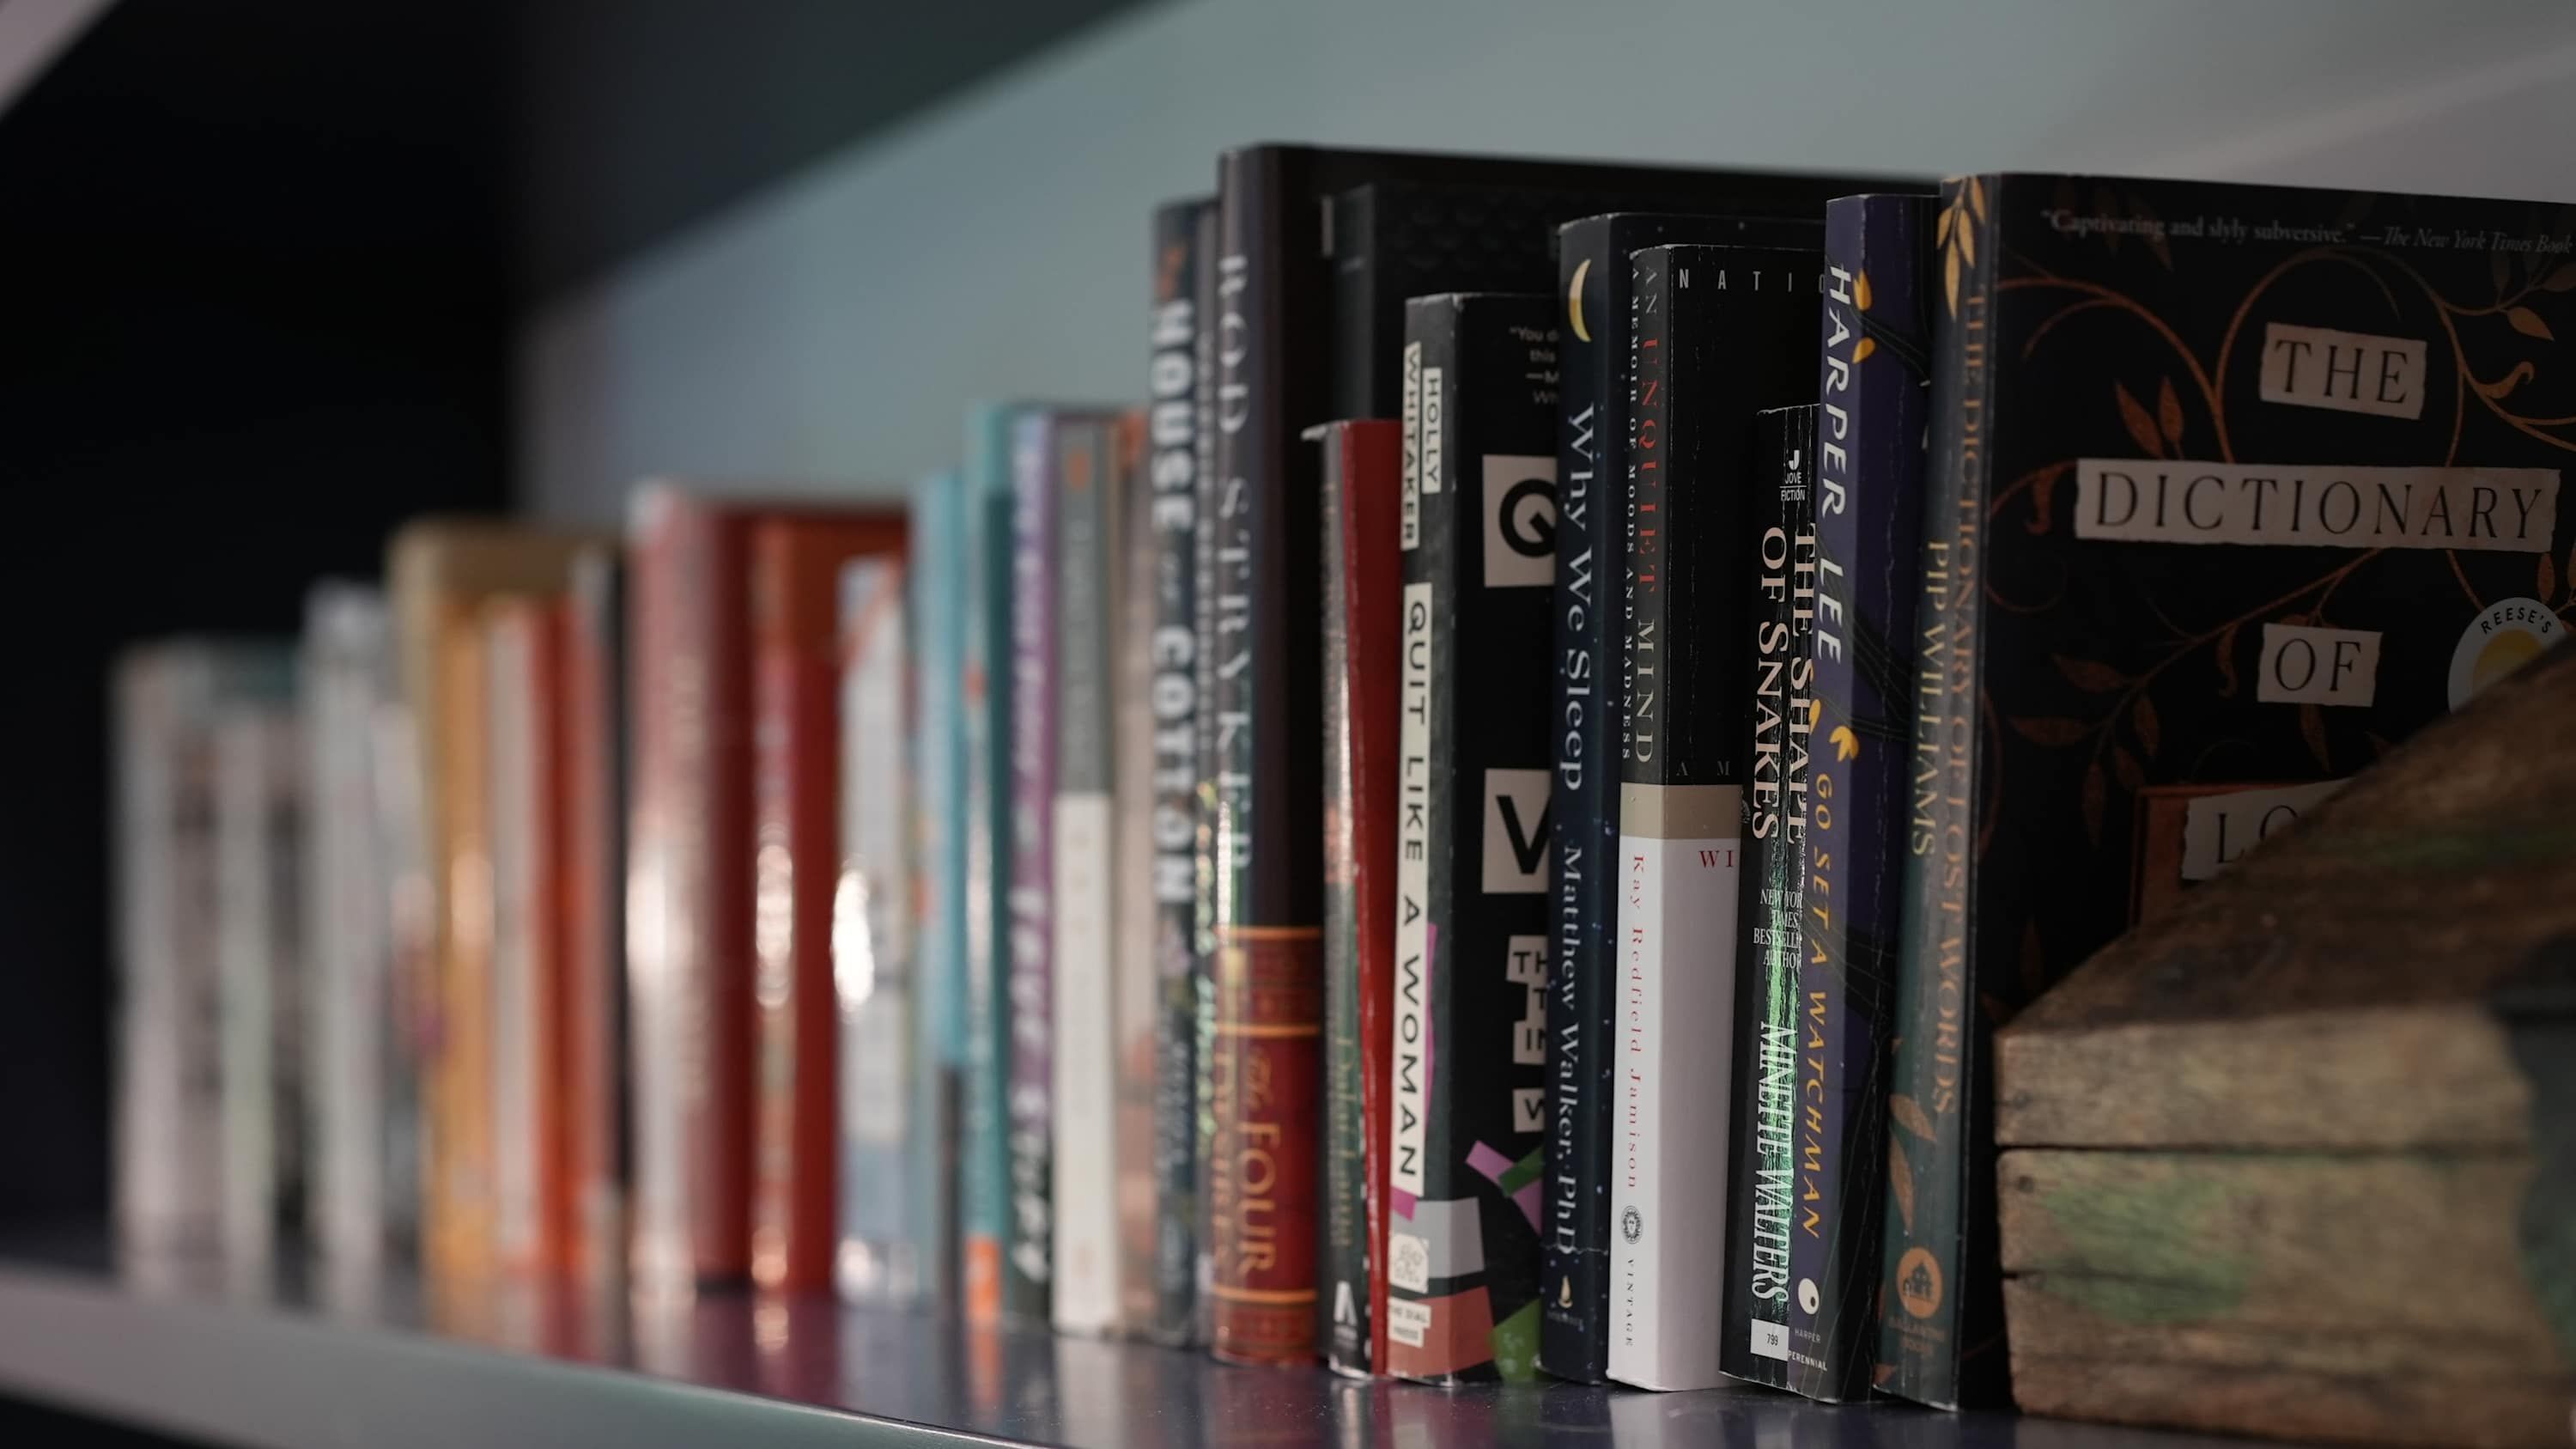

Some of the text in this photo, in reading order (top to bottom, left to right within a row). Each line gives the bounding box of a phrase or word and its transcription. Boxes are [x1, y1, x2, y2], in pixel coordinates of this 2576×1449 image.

[2169, 216, 2204, 237] and
[2208, 216, 2248, 244] slyly
[2415, 228, 2450, 248] New
[2452, 228, 2488, 250] York
[2490, 231, 2532, 253] Times
[2535, 233, 2573, 254] Book
[1629, 295, 1639, 402] MEMOIR
[1965, 284, 1986, 385] THE
[2274, 338, 2410, 405] THE
[1403, 347, 1419, 540] WHITAKER
[1425, 376, 1440, 485] HOLLY
[1627, 417, 1637, 449] OF
[1785, 472, 1801, 484] JOVE
[1817, 261, 1852, 665] HARPER LEE
[1626, 464, 1637, 553] MOODS
[1780, 489, 1805, 502] FICTION
[1951, 399, 1981, 701] DICTIONARY
[2095, 470, 2543, 539] DICTIONARY
[1558, 400, 1595, 791] Why We Sleep
[1625, 567, 1635, 620] AND
[2481, 606, 2552, 634] REESE'S
[1621, 635, 1633, 760] MADNESS
[1635, 618, 1656, 763] MIND
[1753, 526, 1789, 839] OF SNAKES
[1787, 521, 1816, 844] THE SHAPE
[1911, 540, 1950, 856] PIP WILLIAMS
[2274, 637, 2362, 693] OF
[1400, 601, 1426, 1175] QUIT LIKE A WOMAN
[1561, 844, 1583, 1011] Matthew
[1759, 888, 1803, 909] NEW YOR
[1627, 855, 1644, 1187] Kay Redfield Jamison
[1802, 773, 1833, 1239] GO SET A WATCHMAN
[1934, 936, 1963, 1114] WORDS
[1237, 1120, 1281, 1275] FOUR
[1556, 1173, 1577, 1255] PhD
[1752, 1020, 1798, 1303] MINETTE WALTERS
[1788, 1349, 1828, 1372] PERENNIAL
[1794, 1326, 1821, 1344] HARPER
